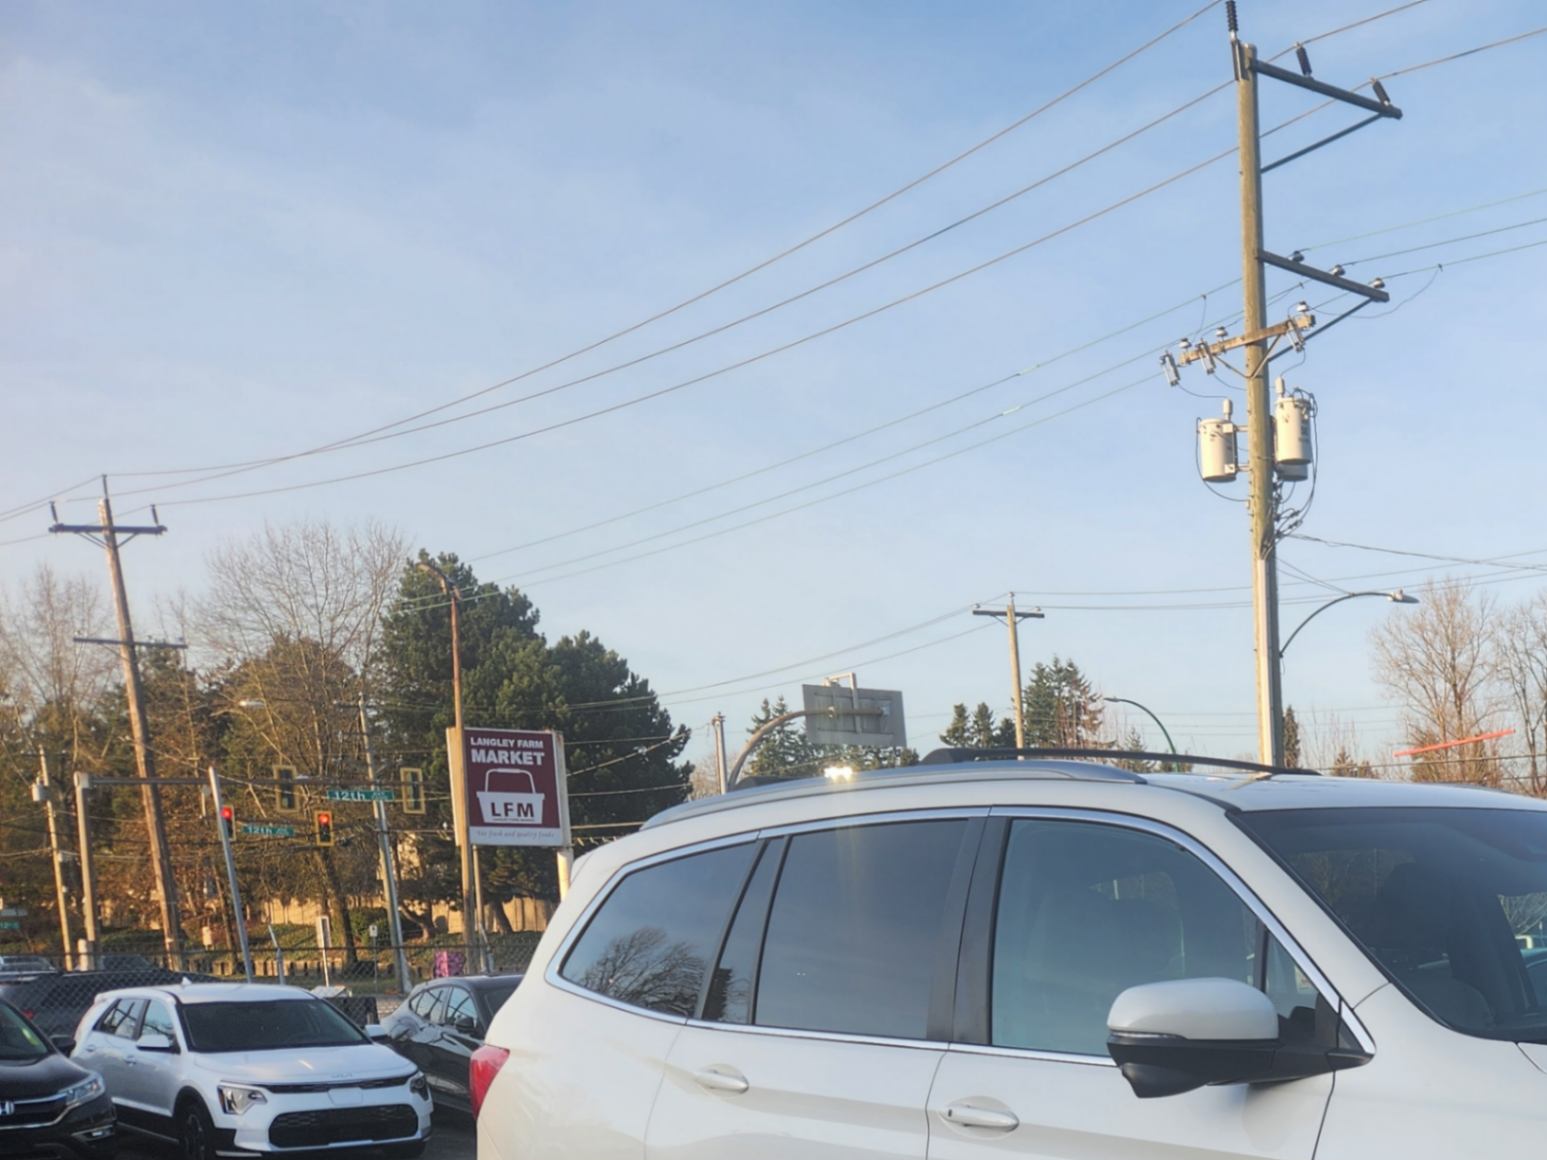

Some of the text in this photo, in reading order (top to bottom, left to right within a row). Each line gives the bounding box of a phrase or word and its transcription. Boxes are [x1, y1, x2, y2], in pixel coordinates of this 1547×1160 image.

[470, 737, 544, 749] LANGLEY FARM
[471, 749, 545, 765] MARKET
[335, 791, 365, 801] 12th
[491, 802, 534, 817] LFM
